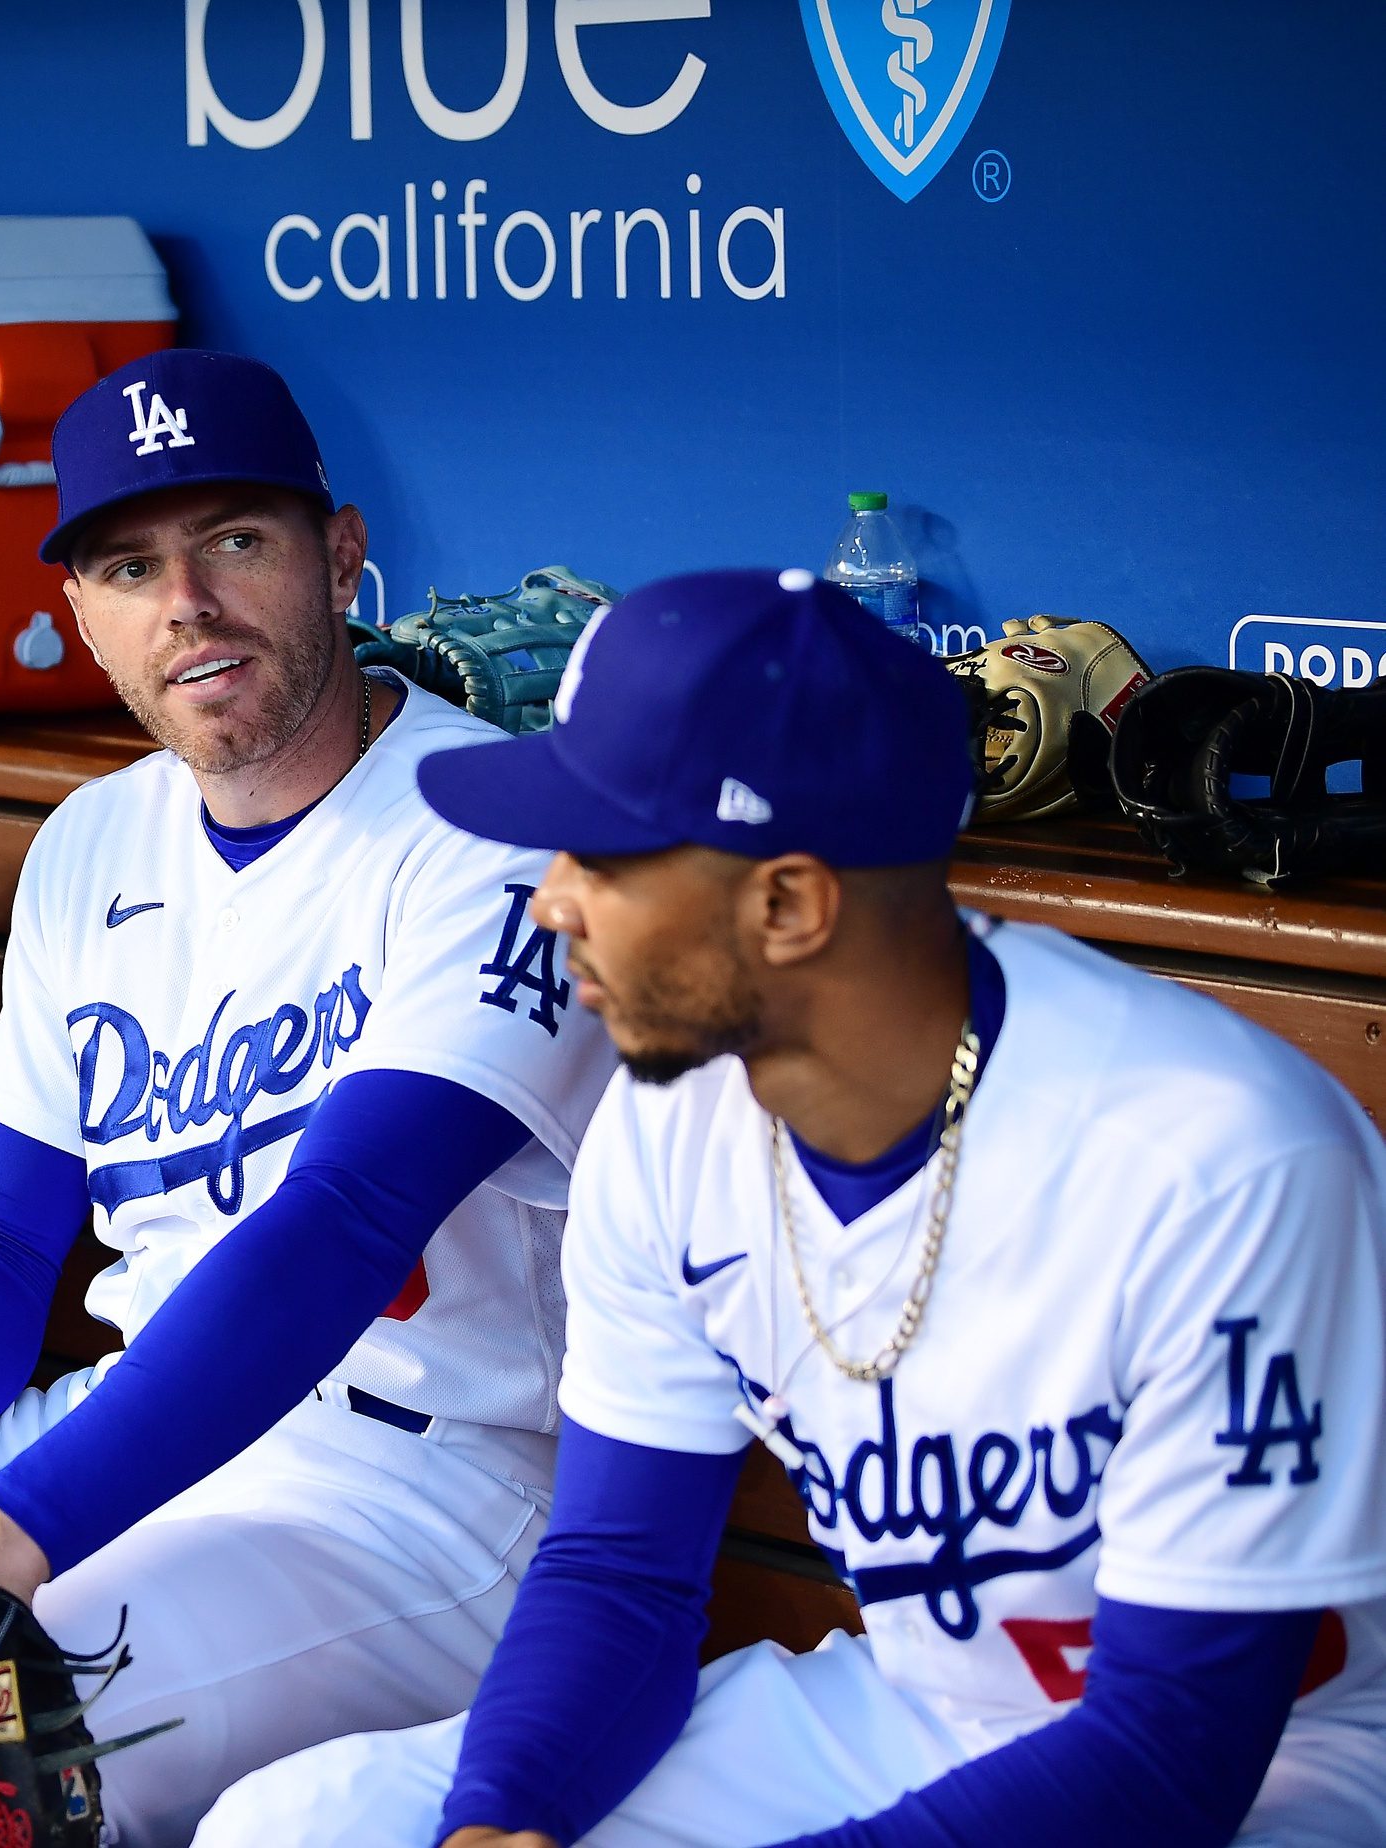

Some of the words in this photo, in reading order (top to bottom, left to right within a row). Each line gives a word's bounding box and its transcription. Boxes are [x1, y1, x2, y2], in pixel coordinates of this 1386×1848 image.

[185, 0, 712, 149] blue
[264, 172, 786, 301] california
[123, 381, 195, 456] LA
[479, 883, 571, 1038] LA
[66, 962, 372, 1215] Dodgers
[1215, 1315, 1322, 1487] LA
